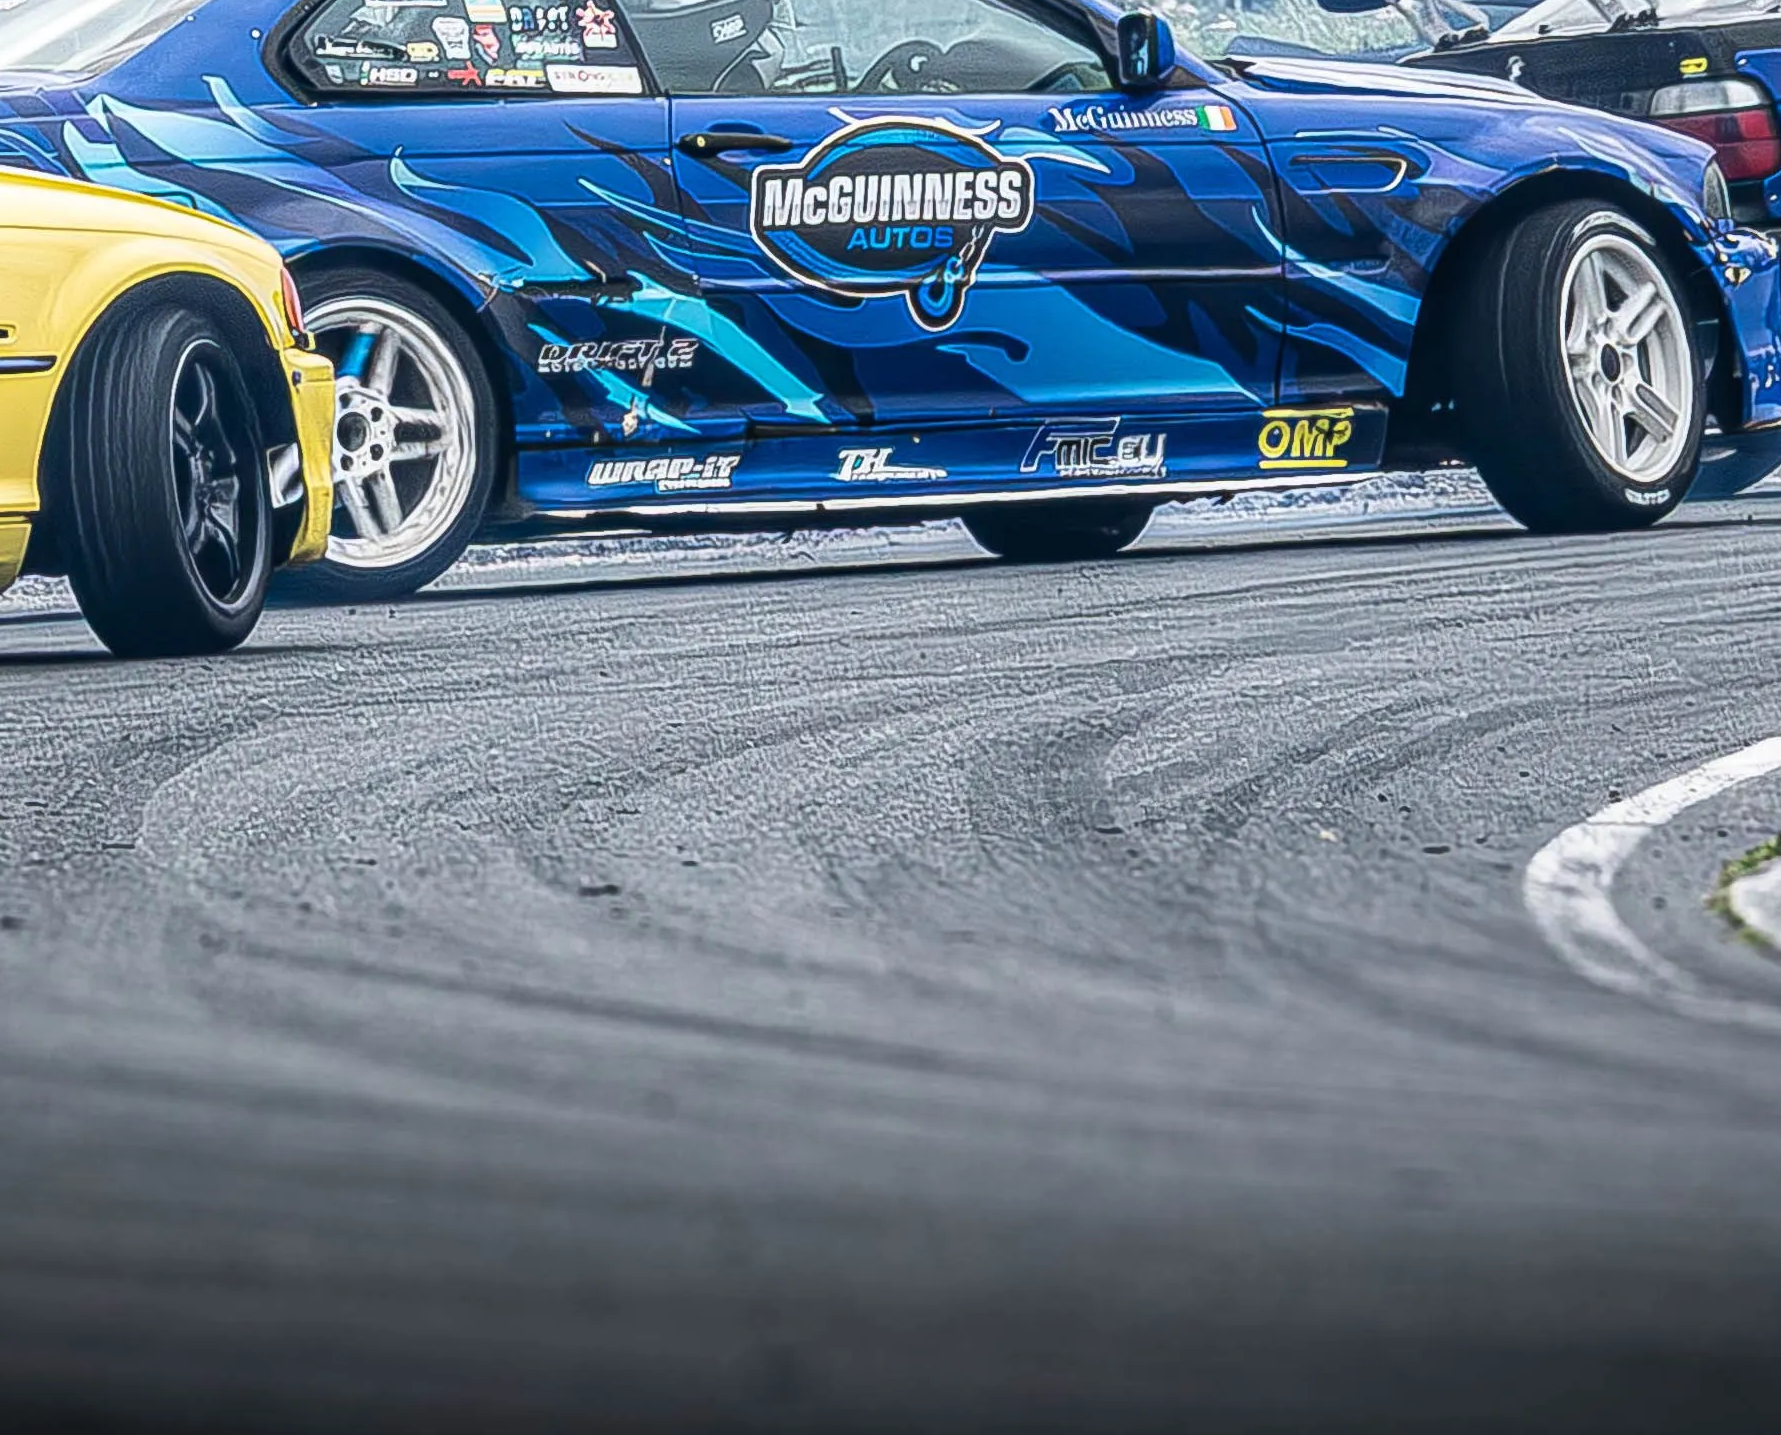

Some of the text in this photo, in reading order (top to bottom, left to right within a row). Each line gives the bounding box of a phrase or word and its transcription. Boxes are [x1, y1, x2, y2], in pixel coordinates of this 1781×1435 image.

[1048, 105, 1198, 132] McGuinness
[762, 170, 1022, 227] McGUINNESS
[846, 226, 954, 250] AUTOS
[1258, 418, 1352, 458] OMP
